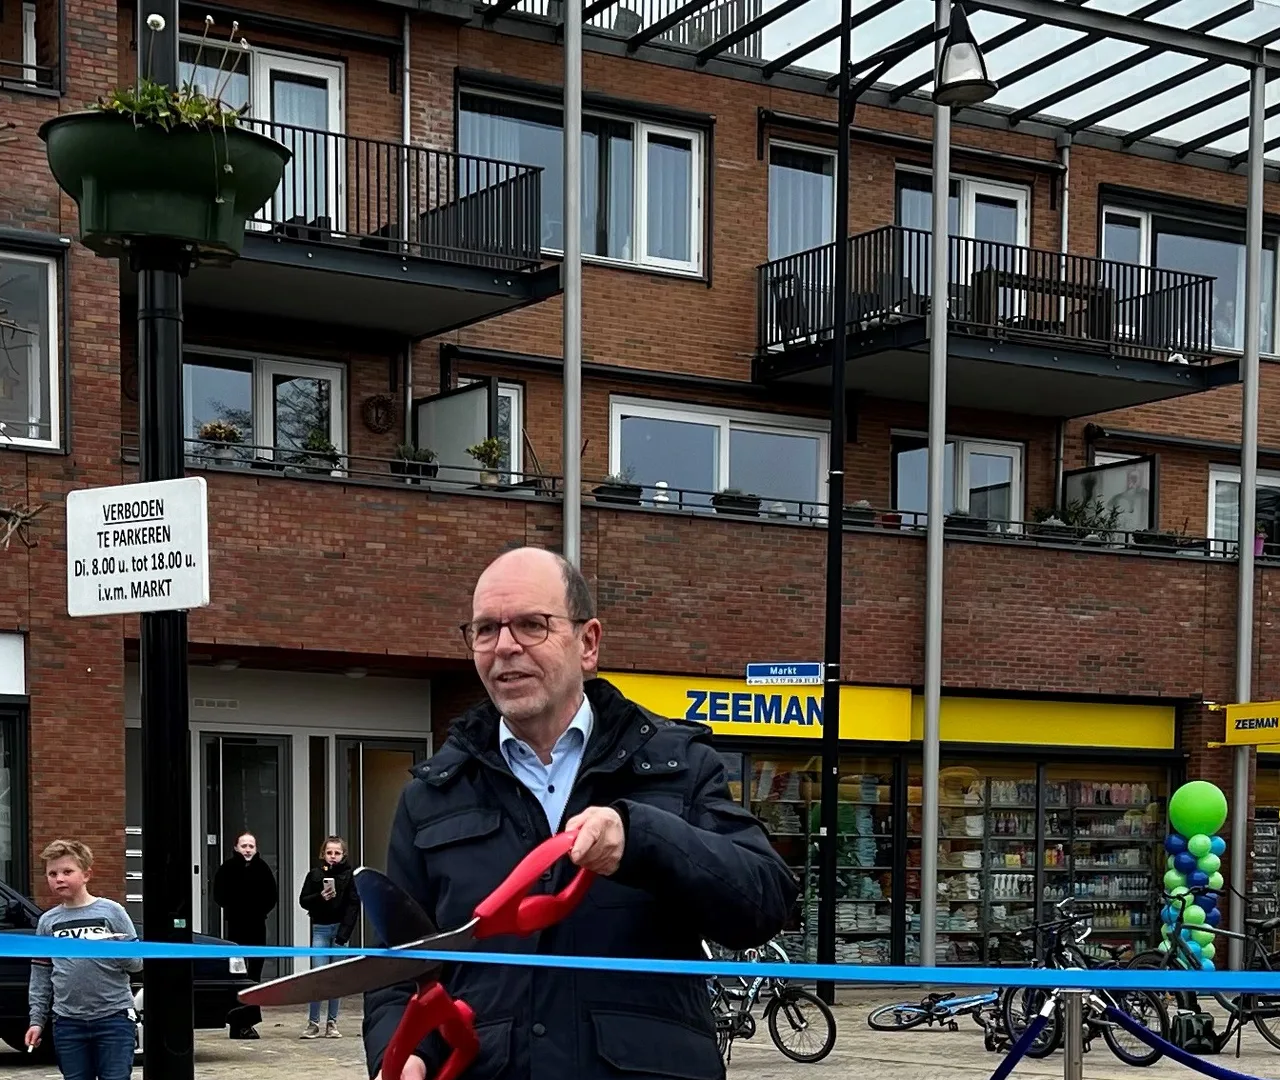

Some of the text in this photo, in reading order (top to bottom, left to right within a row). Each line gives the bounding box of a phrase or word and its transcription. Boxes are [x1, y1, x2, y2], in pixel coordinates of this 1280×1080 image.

[103, 499, 164, 522] VERBODEN
[97, 525, 171, 548] TE PARKEREN
[74, 551, 196, 577] Di. 8.00 u. tot 18.00 u.
[98, 579, 172, 602] i.v.m. MARKT
[770, 666, 797, 675] Markt
[686, 690, 824, 726] ZEEMAN
[1235, 717, 1279, 730] ZEEMAN
[53, 926, 104, 940] evi's
